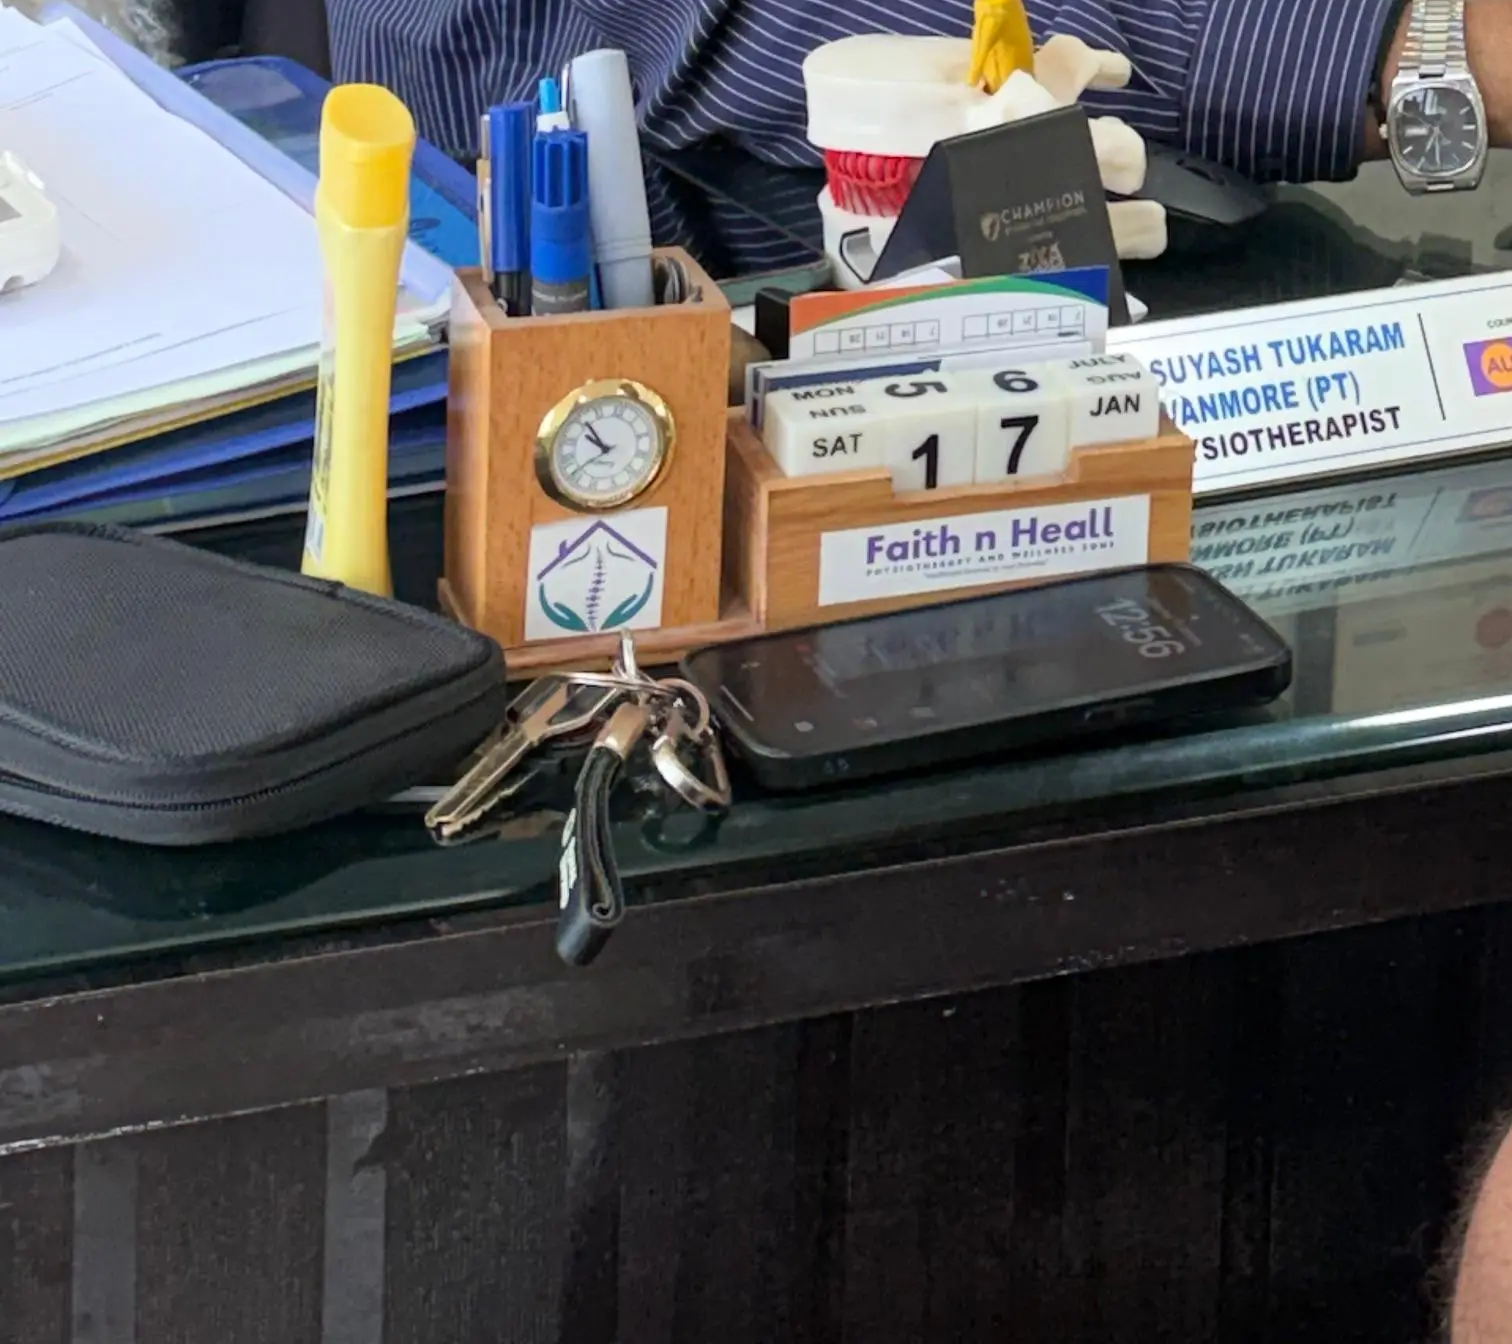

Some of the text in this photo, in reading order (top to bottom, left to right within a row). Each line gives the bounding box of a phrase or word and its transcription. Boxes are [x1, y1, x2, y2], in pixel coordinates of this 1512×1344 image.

[1001, 190, 1085, 224] CHAMPION
[1067, 353, 1127, 370] JULY
[1150, 322, 1405, 389] SUYASH TUKARAM
[790, 385, 855, 401] MON
[884, 381, 948, 398] 5
[1307, 370, 1361, 410] (PT)
[810, 405, 866, 419] SUN
[812, 433, 863, 458] SAT
[1090, 393, 1141, 417] JAN
[866, 506, 1114, 565] Faith n Heall
[866, 557, 972, 577] PHYSIOTHERAPY
[979, 553, 1005, 564] AND
[1097, 596, 1186, 659] 12:56
